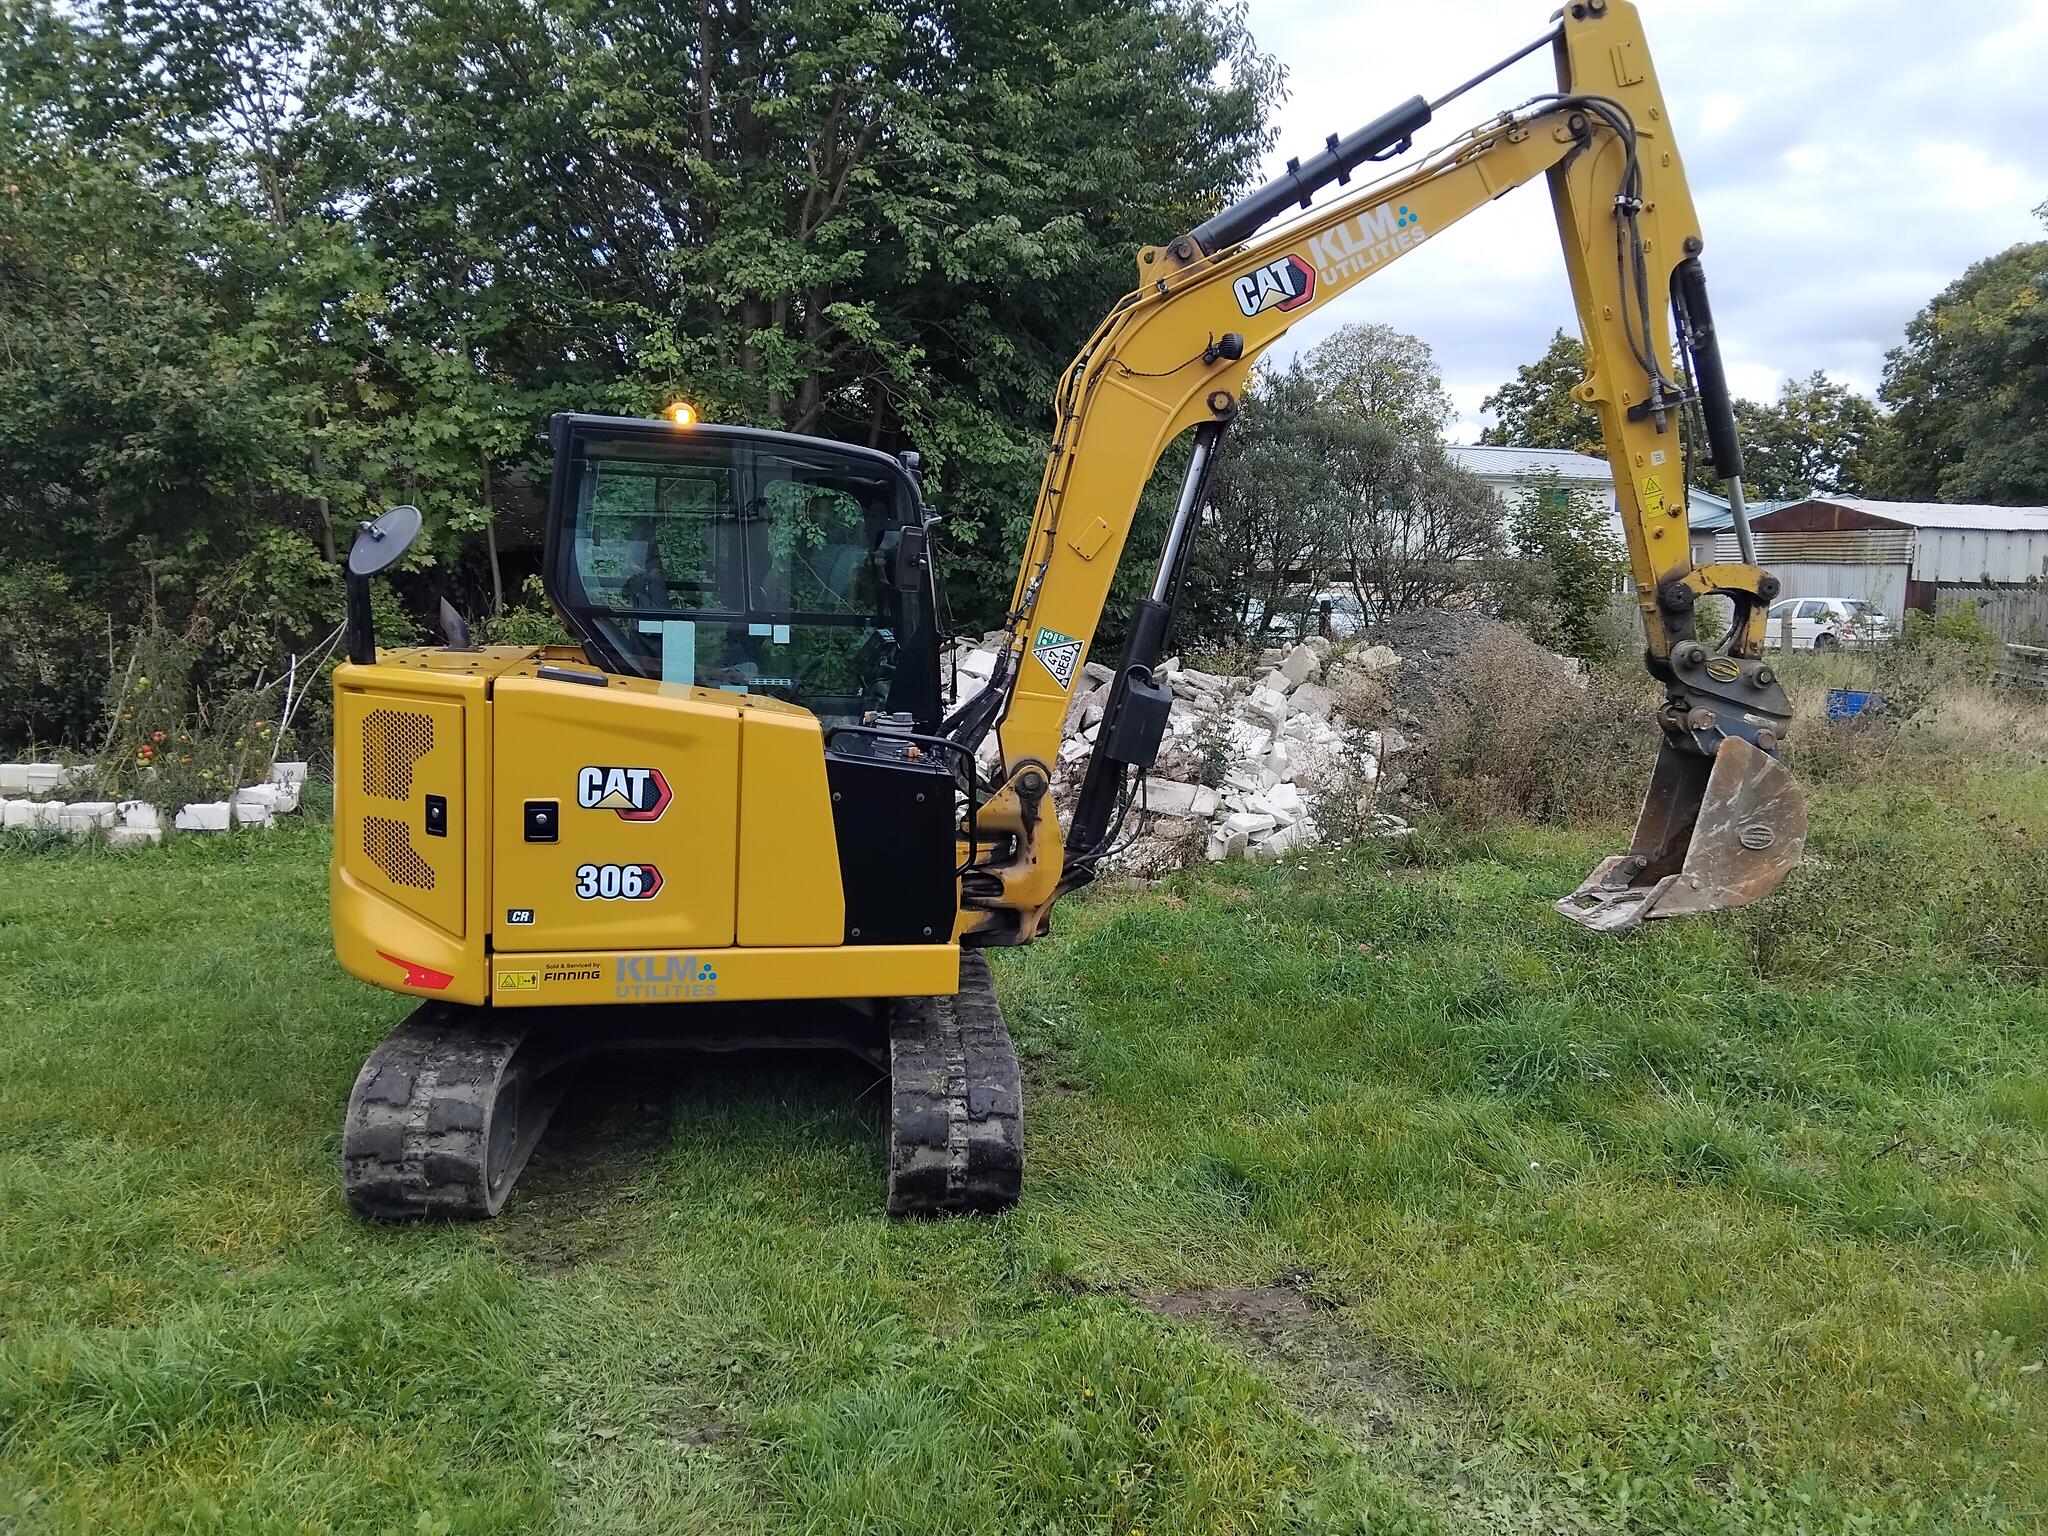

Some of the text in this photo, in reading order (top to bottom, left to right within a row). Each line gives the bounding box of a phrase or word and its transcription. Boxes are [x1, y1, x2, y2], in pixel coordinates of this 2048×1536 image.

[1308, 202, 1398, 269] KLM
[1321, 226, 1426, 286] UTILITIES
[1233, 256, 1297, 316] CAT
[1047, 651, 1059, 665] 47
[578, 767, 650, 809] CAT
[577, 865, 643, 898] 306
[511, 911, 529, 922] CR
[544, 971, 600, 981] FINNING
[616, 957, 697, 982] KLM
[616, 985, 717, 998] UTILITIES
